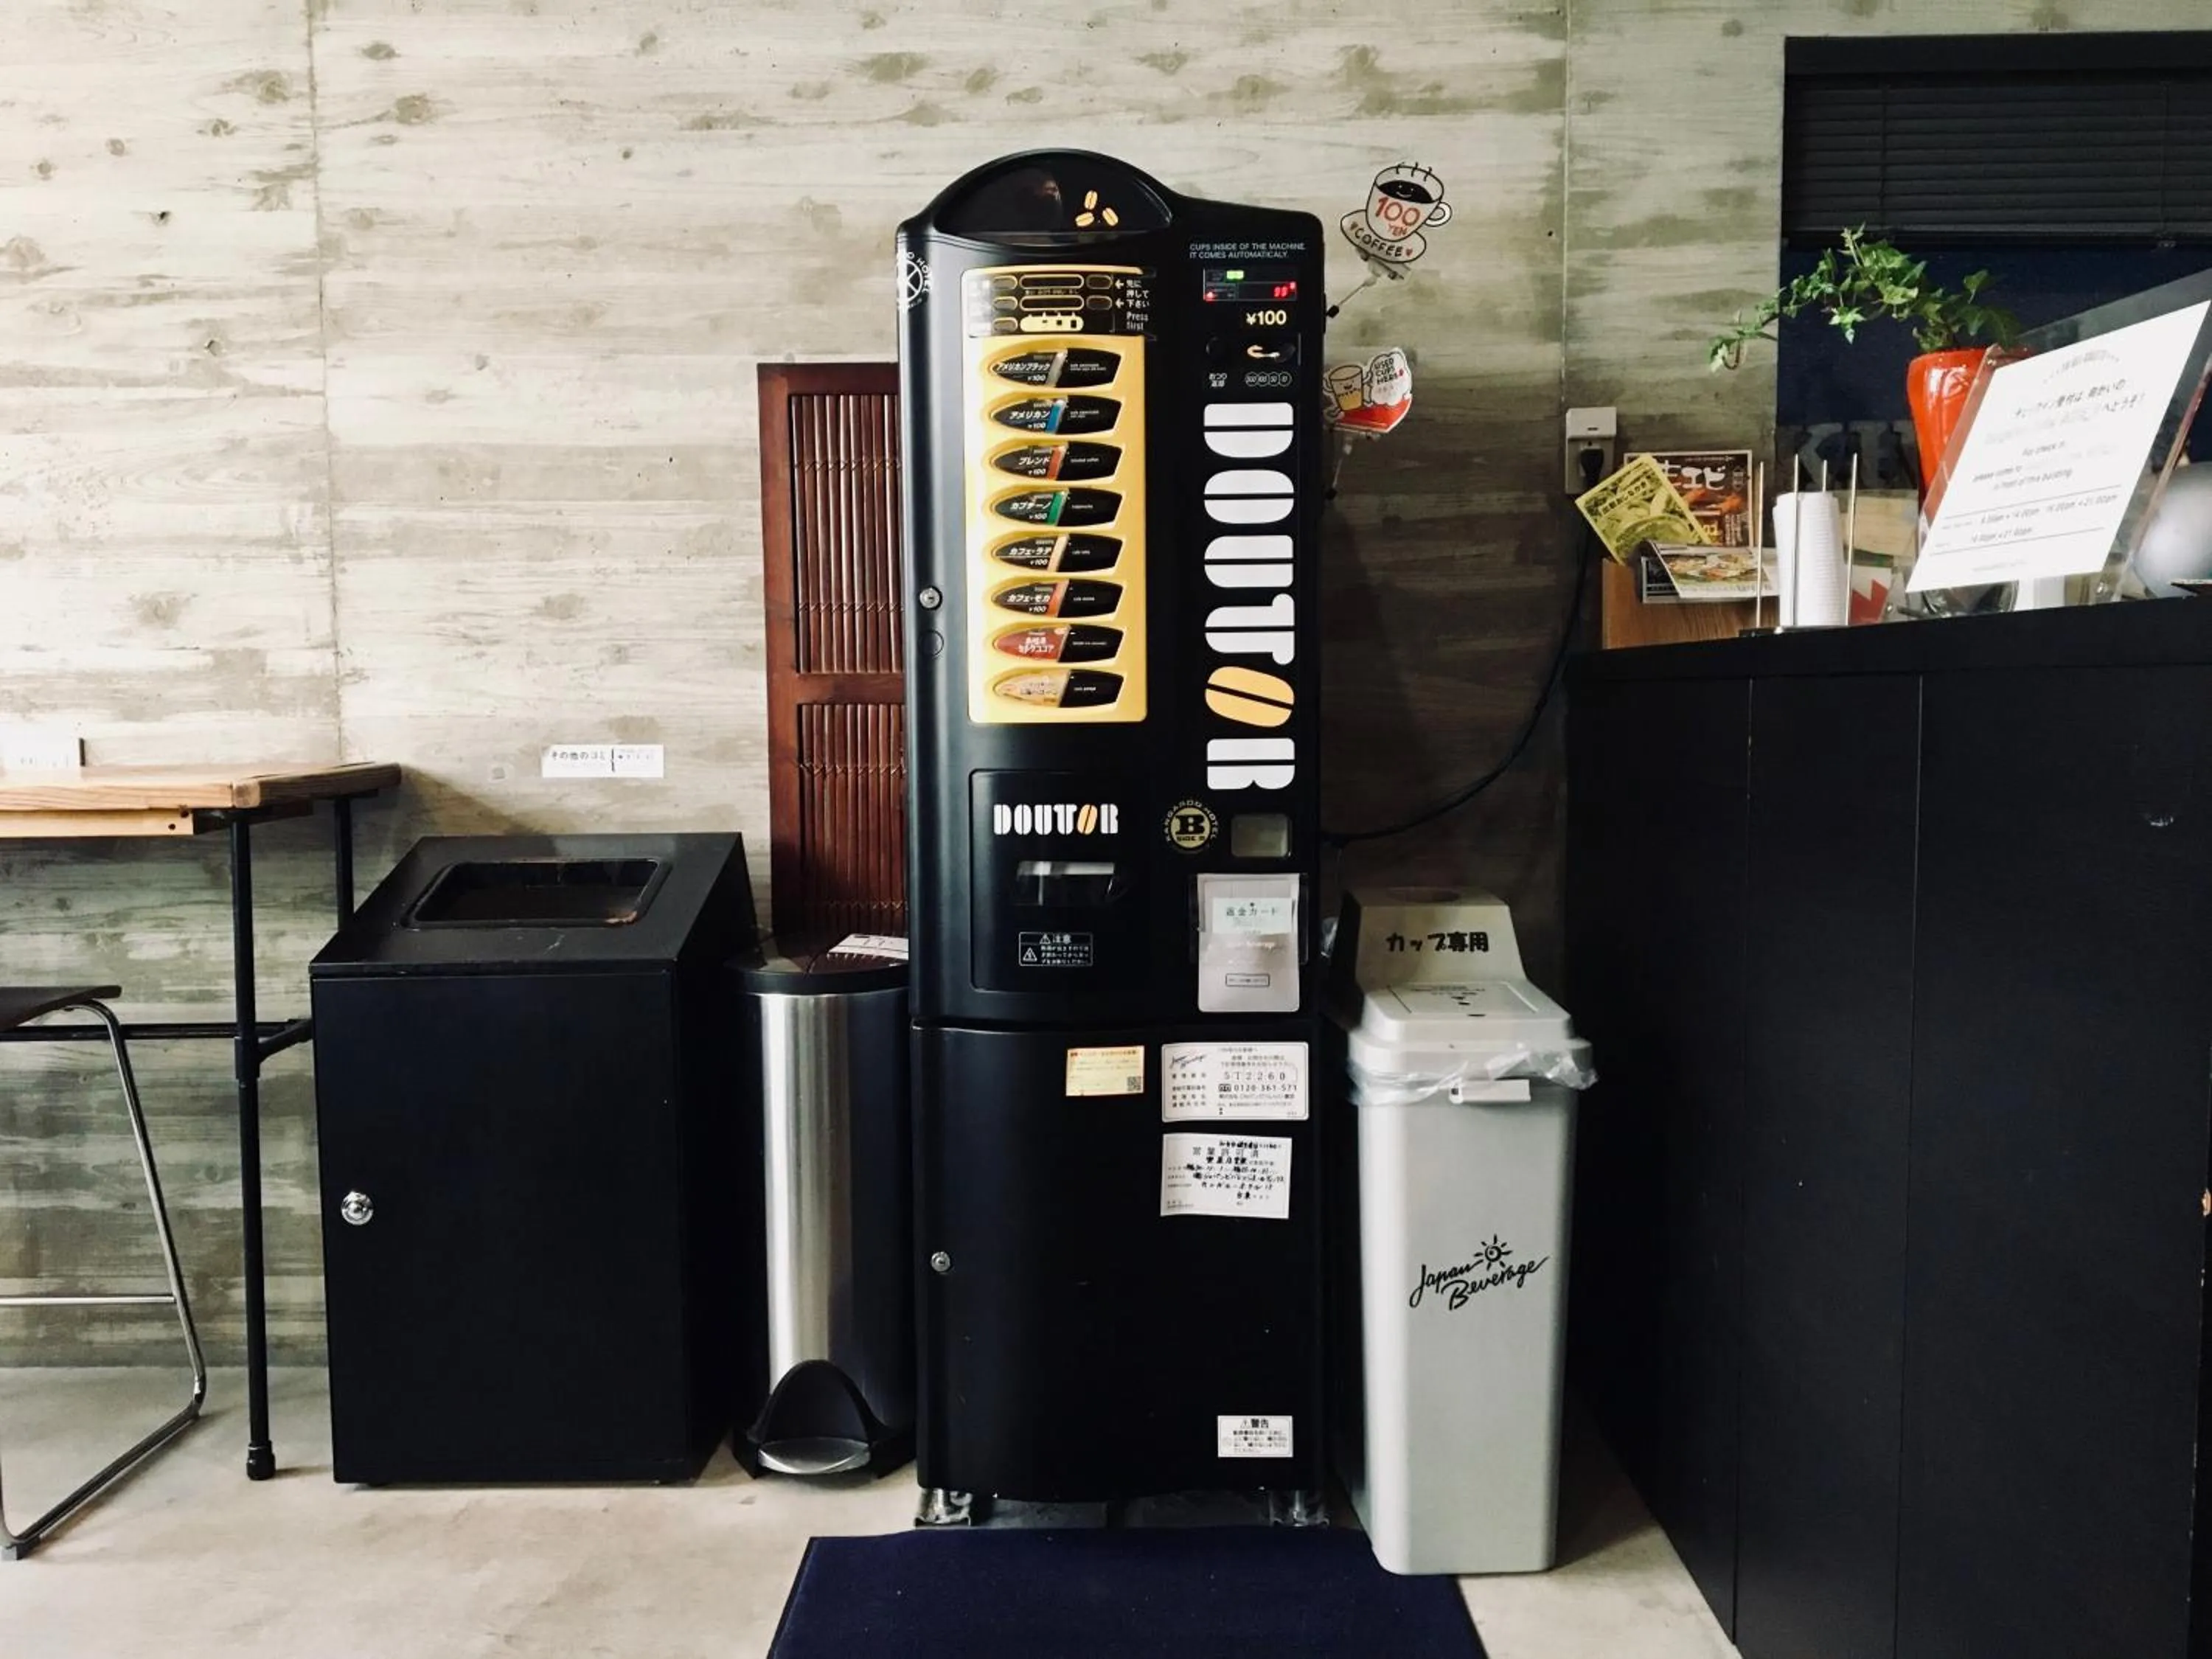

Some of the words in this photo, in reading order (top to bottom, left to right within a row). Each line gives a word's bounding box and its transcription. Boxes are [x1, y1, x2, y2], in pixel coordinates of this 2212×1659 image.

[1375, 196, 1420, 226] 100
[1388, 224, 1408, 236] YEN
[1189, 243, 1211, 251] CUPS
[1354, 228, 1405, 257] COFFEE
[1126, 290, 1150, 299] 押して
[1126, 299, 1150, 308] 下さい
[1126, 312, 1149, 321] Press
[1246, 309, 1287, 325] ¥100
[1126, 321, 1144, 330] first
[1009, 410, 1051, 420] アメリカン
[1018, 456, 1051, 465] ブレンド
[1009, 501, 1051, 510] カプチーノ
[1204, 403, 1295, 790] DOUTOR
[993, 803, 1119, 835] DOUTOR
[1385, 931, 1489, 953] カップ専用
[1409, 1259, 1484, 1308] Japan
[1441, 1256, 1551, 1310] Beverage
